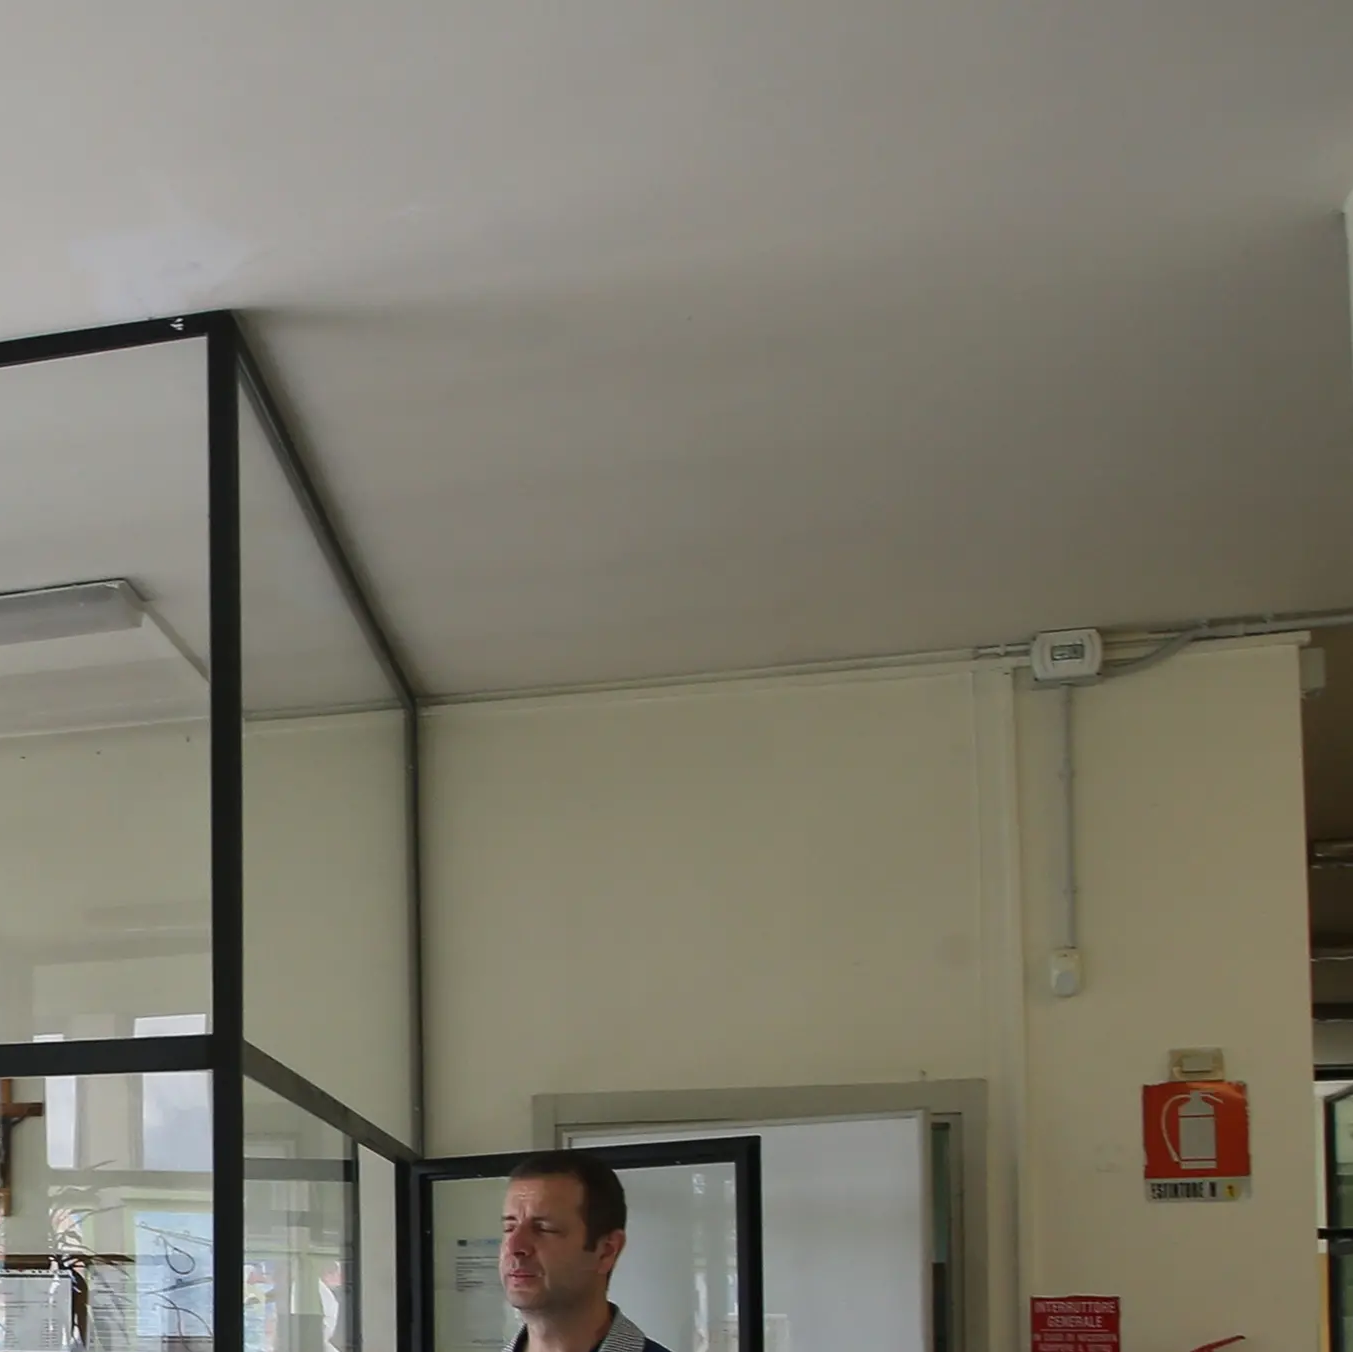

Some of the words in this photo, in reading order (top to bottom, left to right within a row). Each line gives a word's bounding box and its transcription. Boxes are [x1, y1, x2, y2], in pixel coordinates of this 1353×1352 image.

[1150, 1182, 1205, 1199] ESTINTORE
[1034, 1301, 1117, 1313] INTERRUTTORE
[1047, 1315, 1103, 1328] GENERALE
